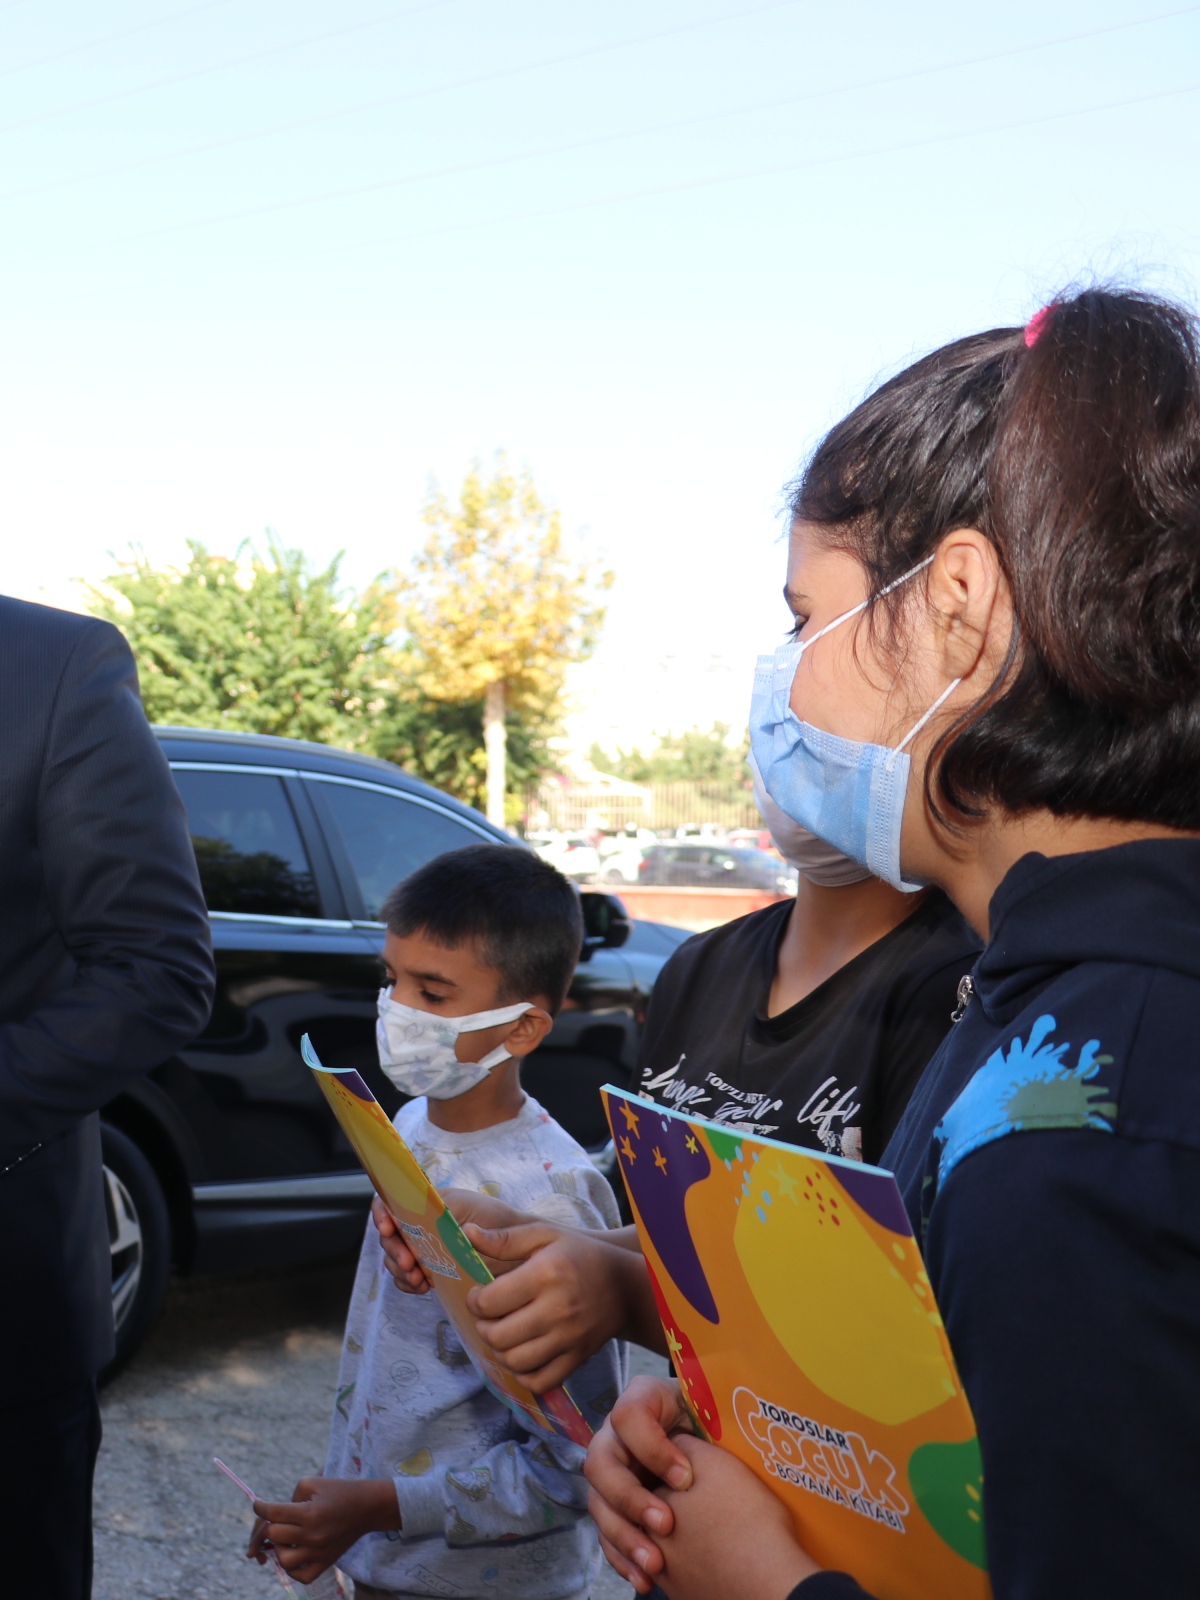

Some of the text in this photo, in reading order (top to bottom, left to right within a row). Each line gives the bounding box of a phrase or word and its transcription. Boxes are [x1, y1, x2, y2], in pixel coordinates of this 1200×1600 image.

[759, 1400, 849, 1450] TOROSLAR
[775, 1463, 904, 1531] BOYAMA KİTABI
